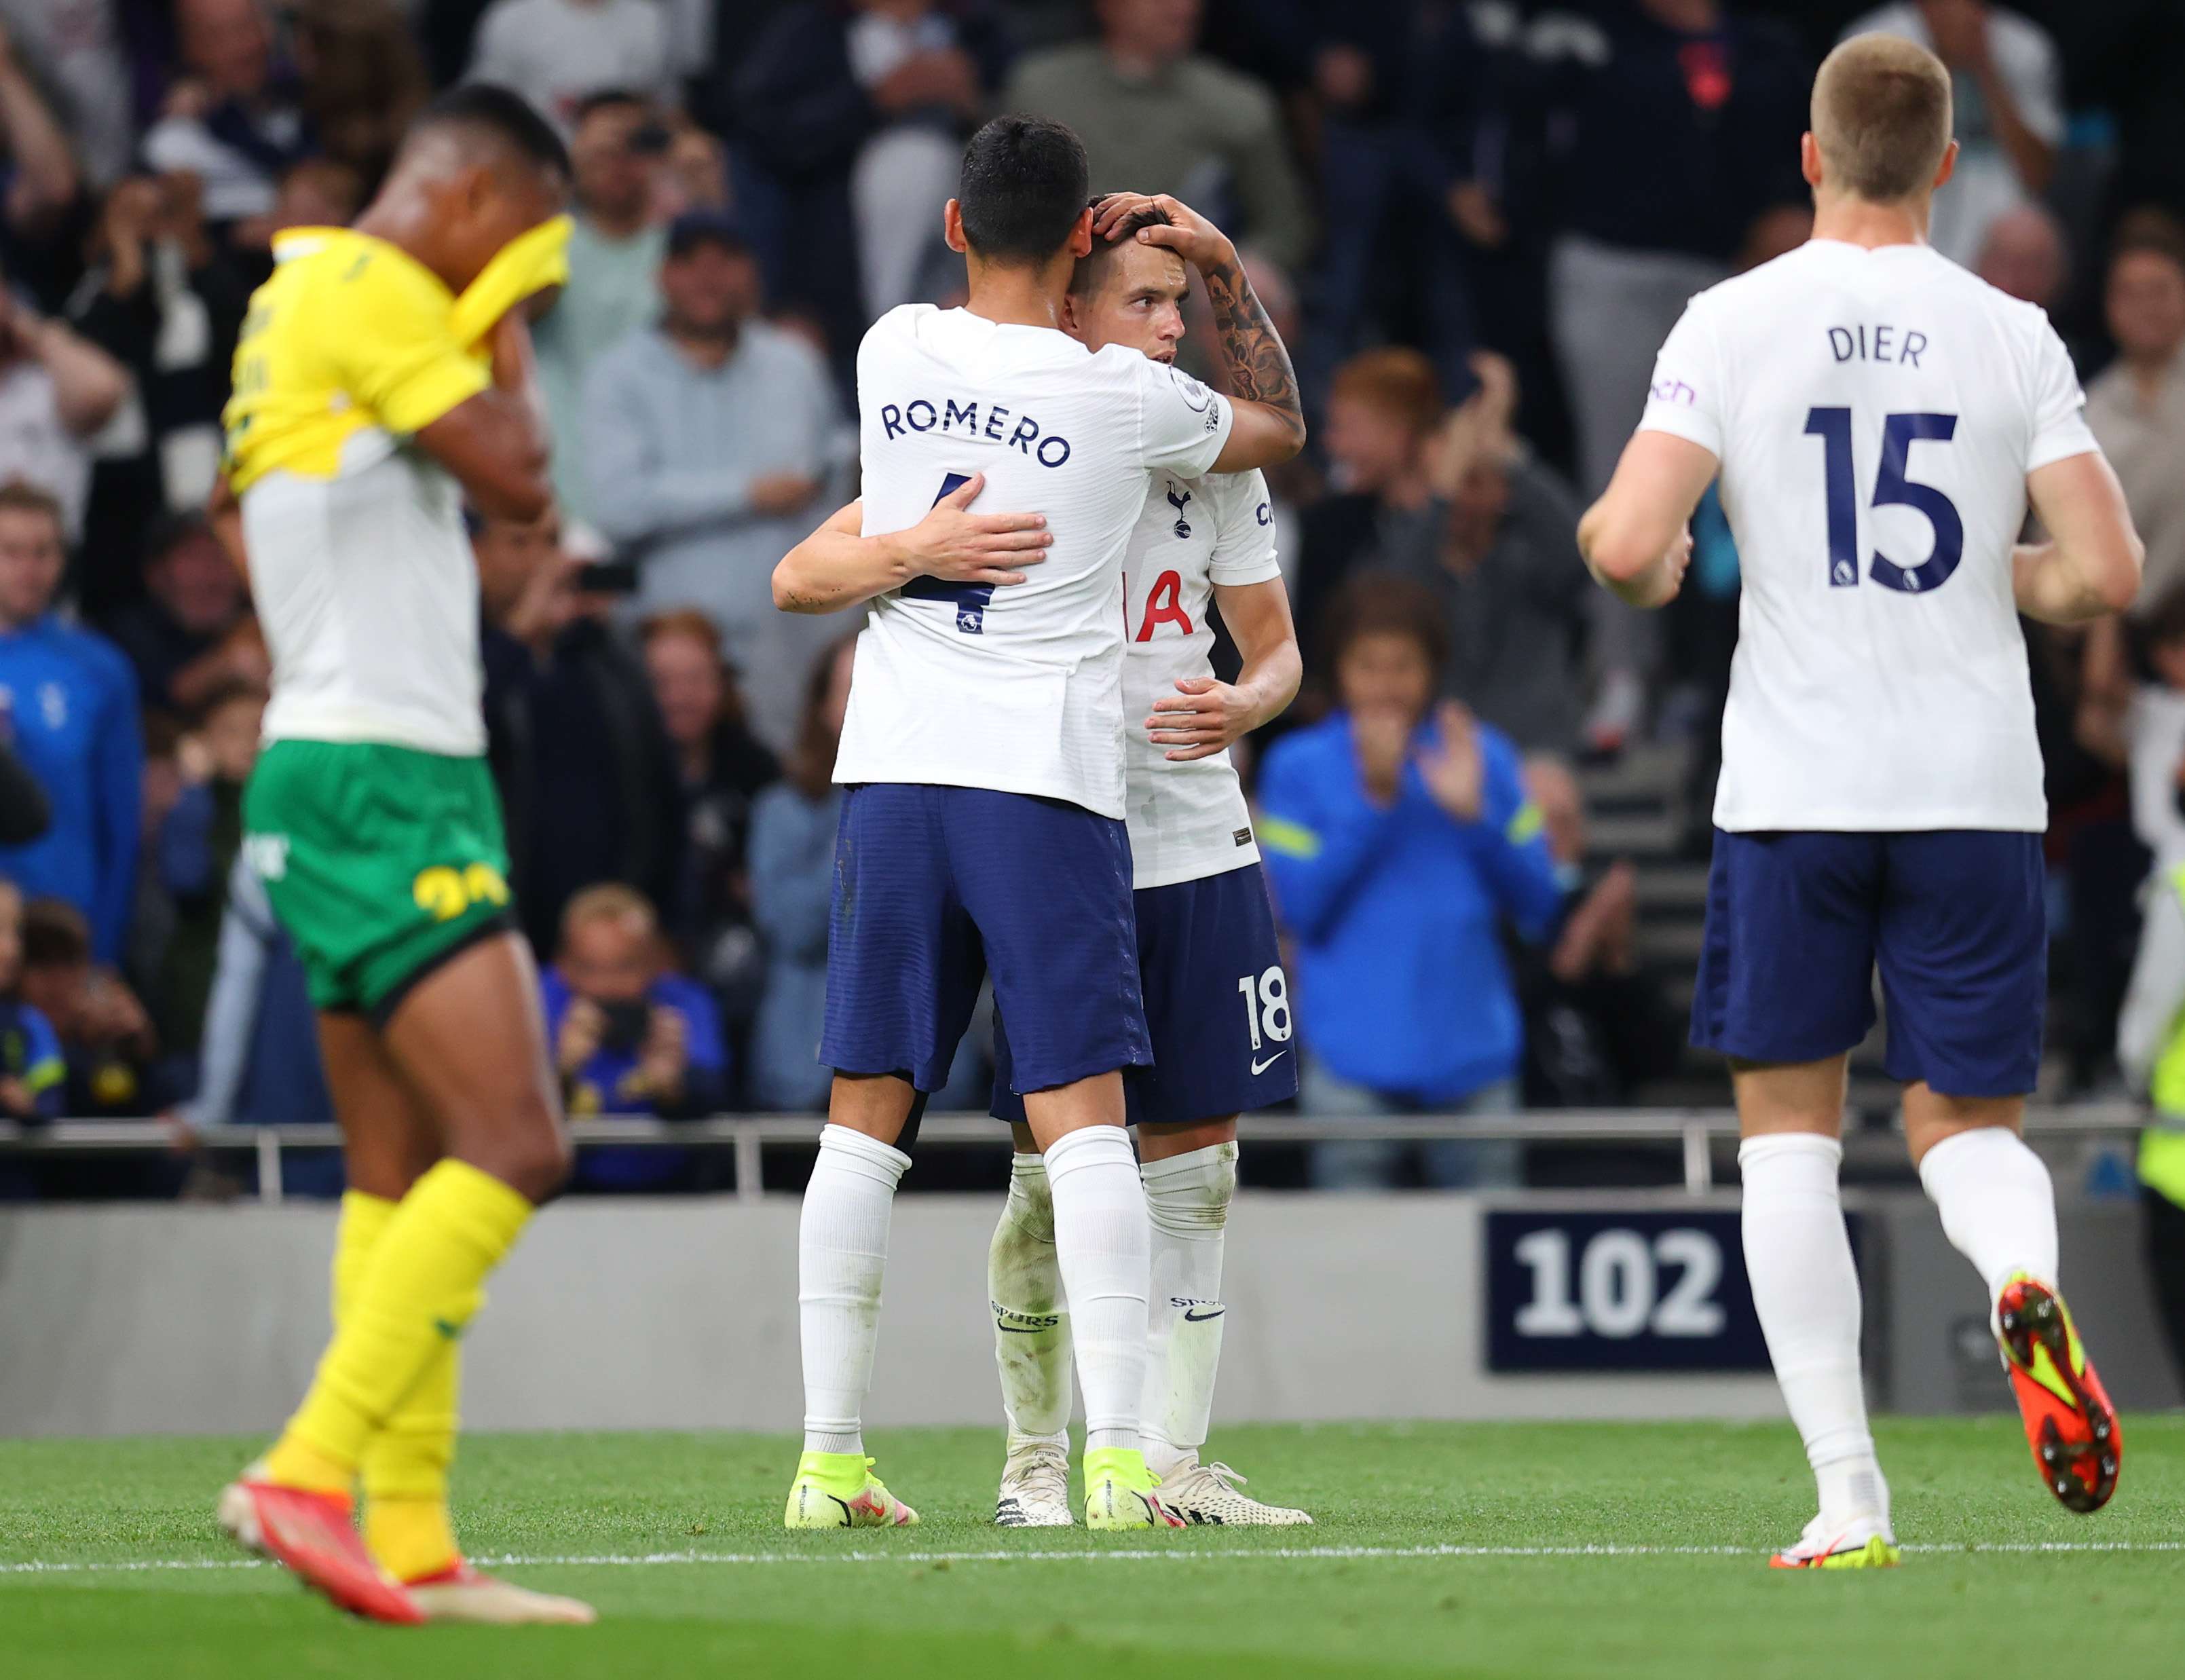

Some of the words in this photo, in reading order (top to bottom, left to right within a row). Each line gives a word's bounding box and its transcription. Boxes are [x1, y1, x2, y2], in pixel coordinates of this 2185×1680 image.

[1827, 324, 1928, 369] DIER
[882, 399, 1070, 468] ROMERO
[1803, 406, 1964, 595] 15
[1238, 965, 1292, 1051] 18
[991, 1300, 1059, 1326] SPURS
[1512, 1229, 1726, 1339] 102
